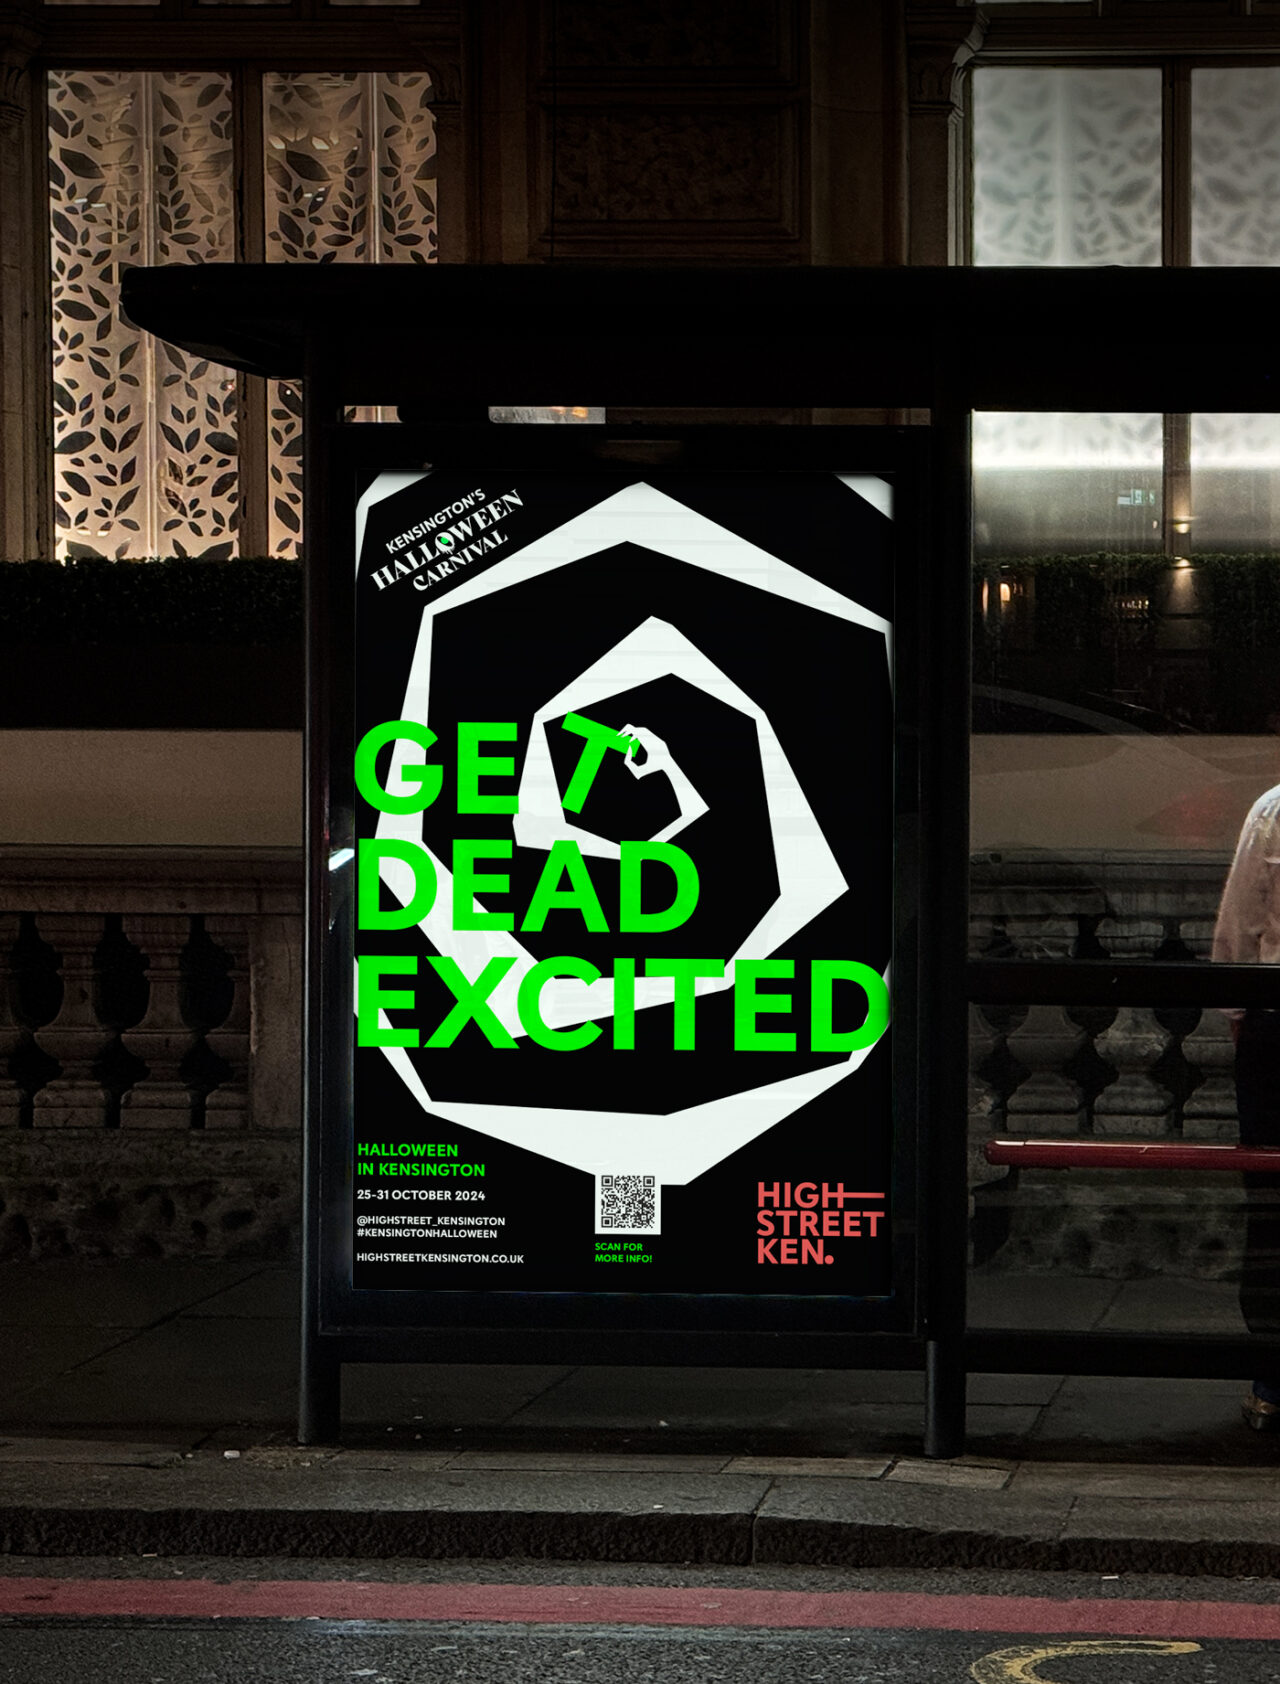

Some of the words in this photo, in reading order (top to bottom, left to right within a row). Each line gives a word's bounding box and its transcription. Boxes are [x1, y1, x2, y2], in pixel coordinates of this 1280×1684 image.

[386, 488, 486, 554] KENSINGTON'S
[370, 489, 524, 591] HALLOWEEN
[413, 529, 509, 591] CARNIVAL
[354, 711, 641, 816] GET
[357, 838, 700, 933] DEAD
[357, 955, 890, 1053] EXCITED
[357, 1143, 458, 1157] HALLOWEEN
[357, 1162, 374, 1175] IN
[379, 1163, 486, 1177] KENSINGTON
[357, 1189, 389, 1200] 25-31
[391, 1190, 452, 1201] OCTOBER
[455, 1190, 486, 1201] 2024
[757, 1182, 885, 1208] HIGH
[357, 1215, 506, 1227] @HIGHSTREET_KENSINGTON
[357, 1228, 498, 1239] #KENSINGTONHALLOWEEN
[757, 1209, 885, 1237] STREET
[357, 1252, 525, 1264] HIGHSTREETKENSINGTON.CO.UK
[595, 1242, 621, 1251] SCAN
[623, 1242, 643, 1252] FOR
[595, 1254, 625, 1263] MORE
[626, 1254, 653, 1263] INFO!
[757, 1238, 834, 1265] KEN.
